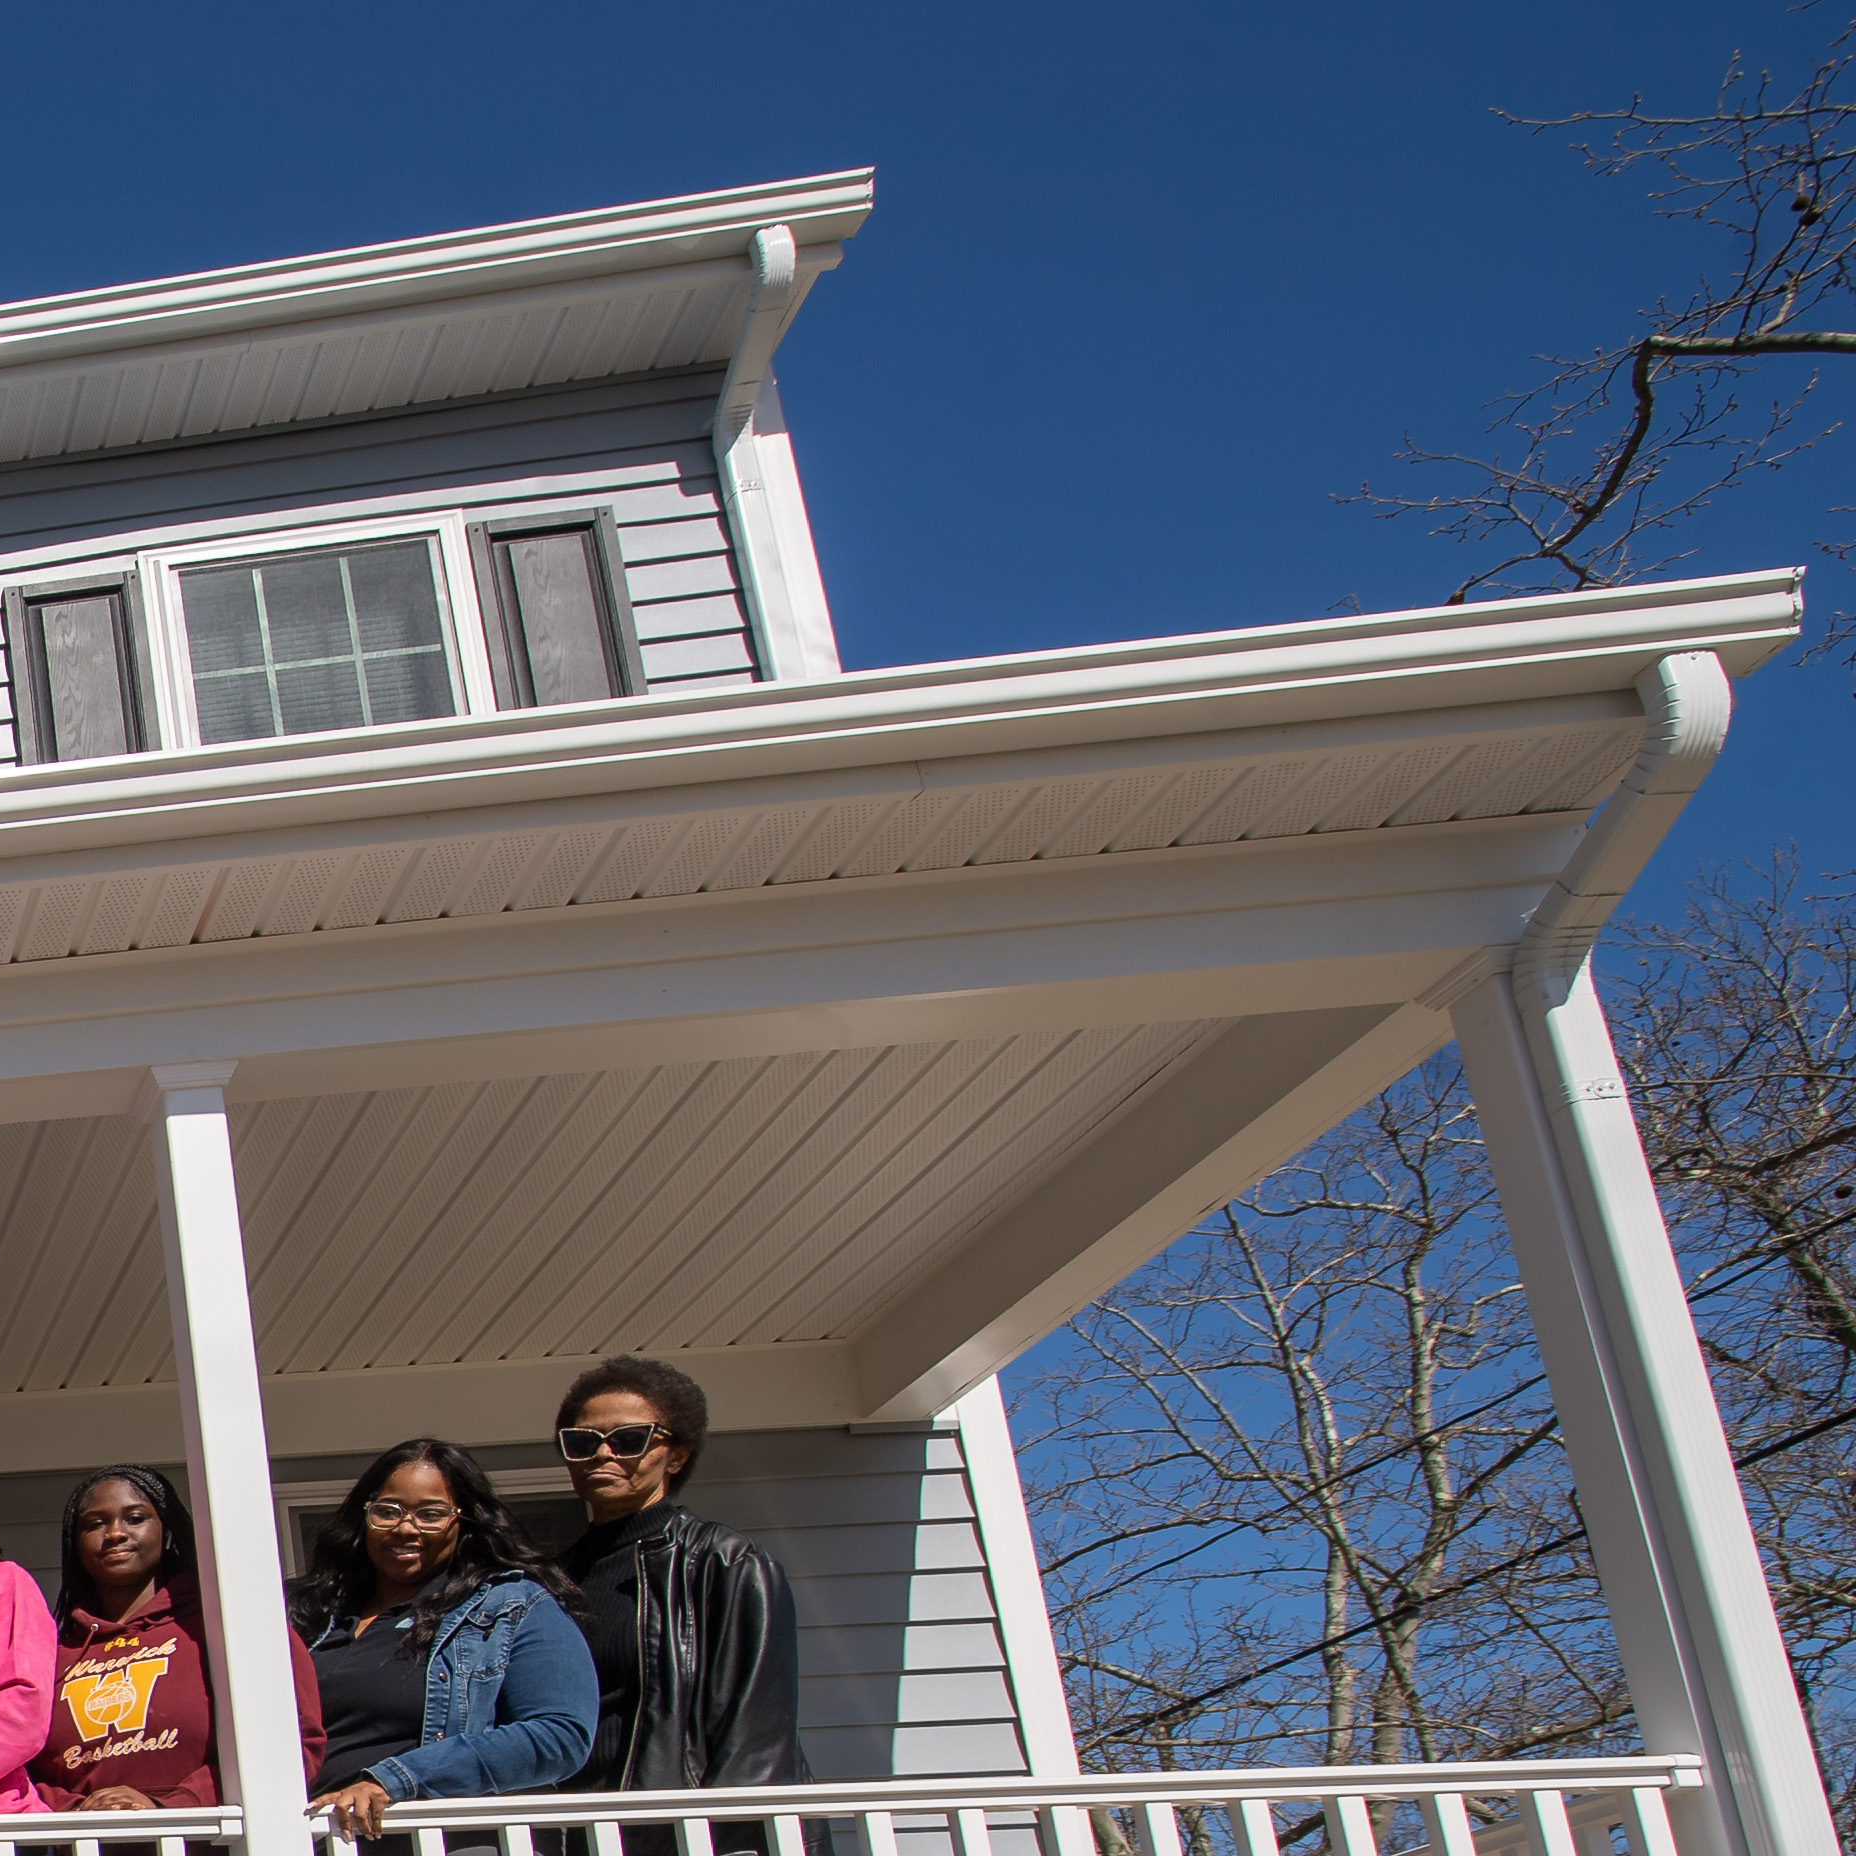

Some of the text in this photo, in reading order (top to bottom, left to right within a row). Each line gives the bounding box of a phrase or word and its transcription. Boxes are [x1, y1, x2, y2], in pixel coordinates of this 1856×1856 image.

[64, 1638, 177, 1681] Warwick
[60, 1657, 168, 1742] W
[90, 1692, 131, 1709] RAIDERS
[64, 1728, 178, 1769] Basketball
